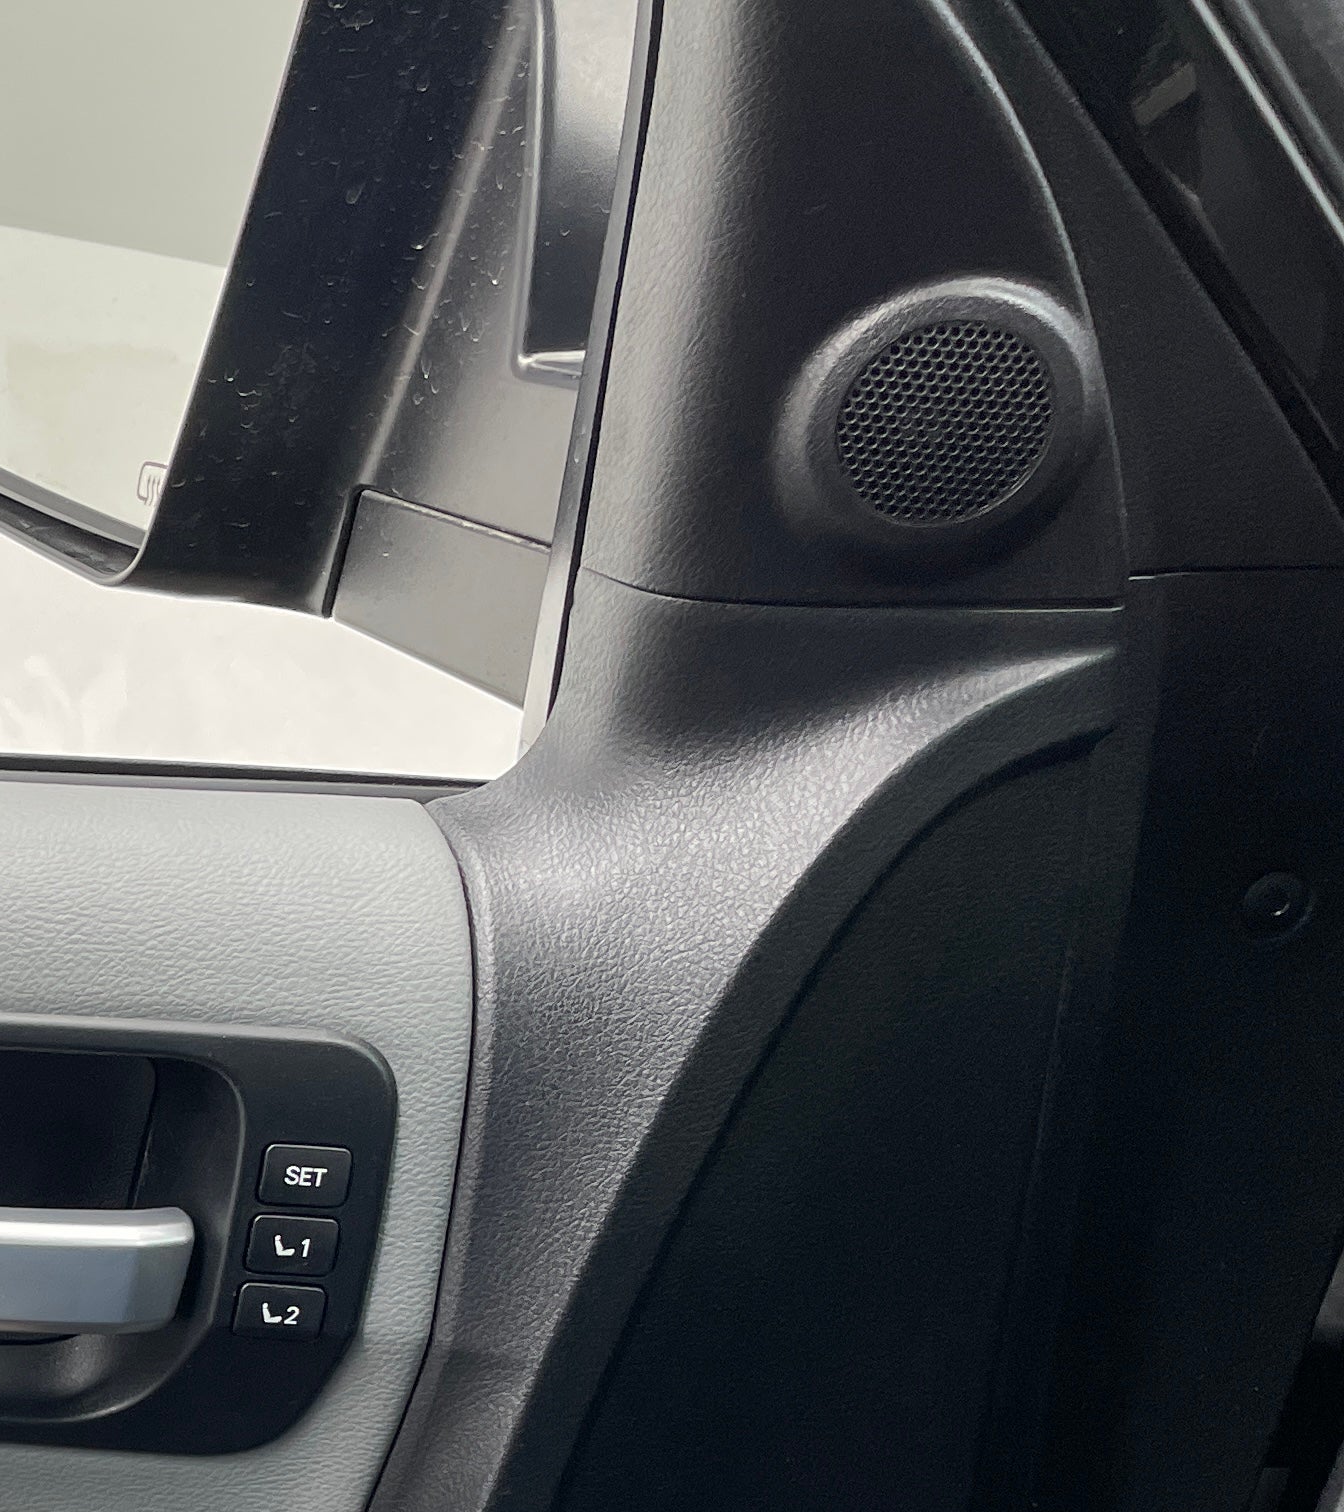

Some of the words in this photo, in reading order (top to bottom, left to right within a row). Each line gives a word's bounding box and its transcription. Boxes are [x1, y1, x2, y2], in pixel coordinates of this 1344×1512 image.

[284, 1166, 328, 1187] SET
[301, 1238, 311, 1258] 1
[283, 1306, 300, 1325] 2
